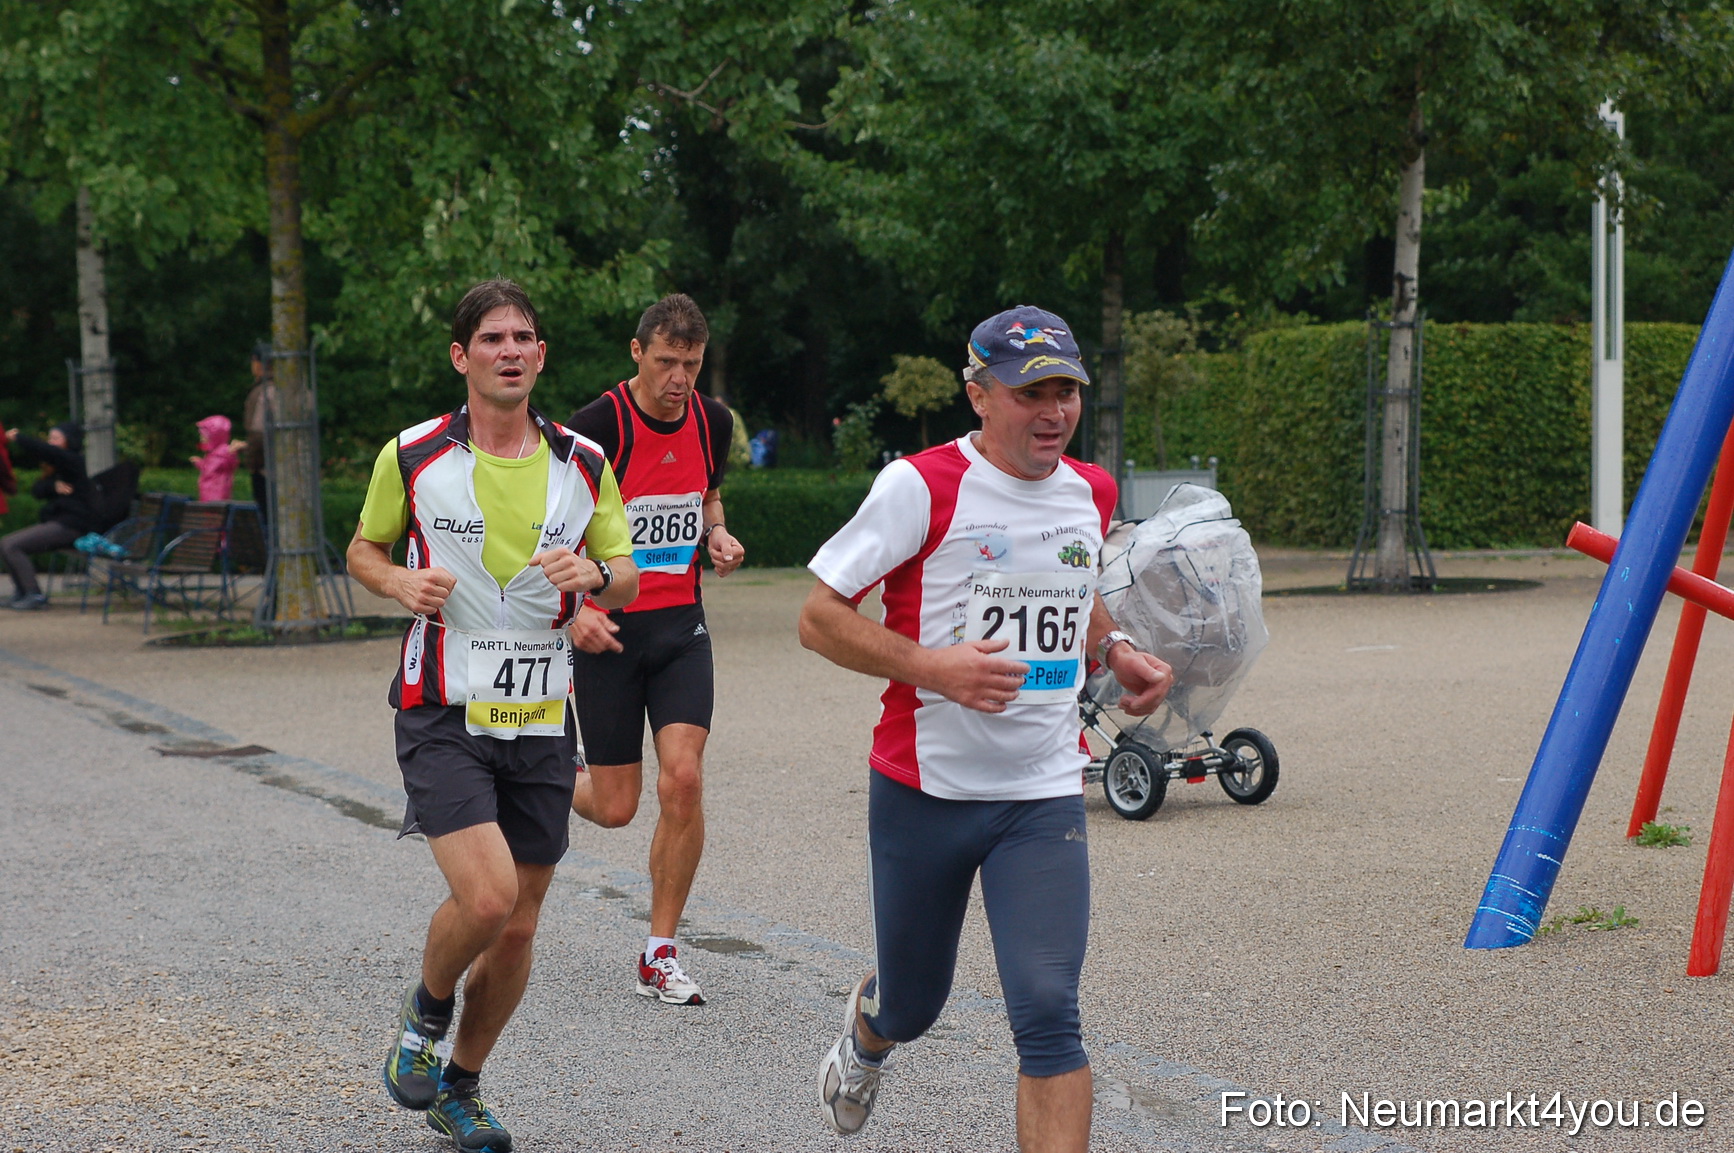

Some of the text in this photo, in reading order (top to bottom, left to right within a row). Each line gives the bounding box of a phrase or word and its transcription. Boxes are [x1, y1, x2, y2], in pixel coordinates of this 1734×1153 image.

[626, 501, 694, 513] PARTL Neumarkt
[631, 511, 698, 545] 2868
[1040, 531, 1054, 542] D.
[645, 550, 678, 565] Stefan
[973, 584, 1075, 598] PARTL Neumarkt
[981, 605, 1079, 653] 2165
[471, 640, 555, 651] PARTL Neumarkt
[493, 656, 552, 697] 477
